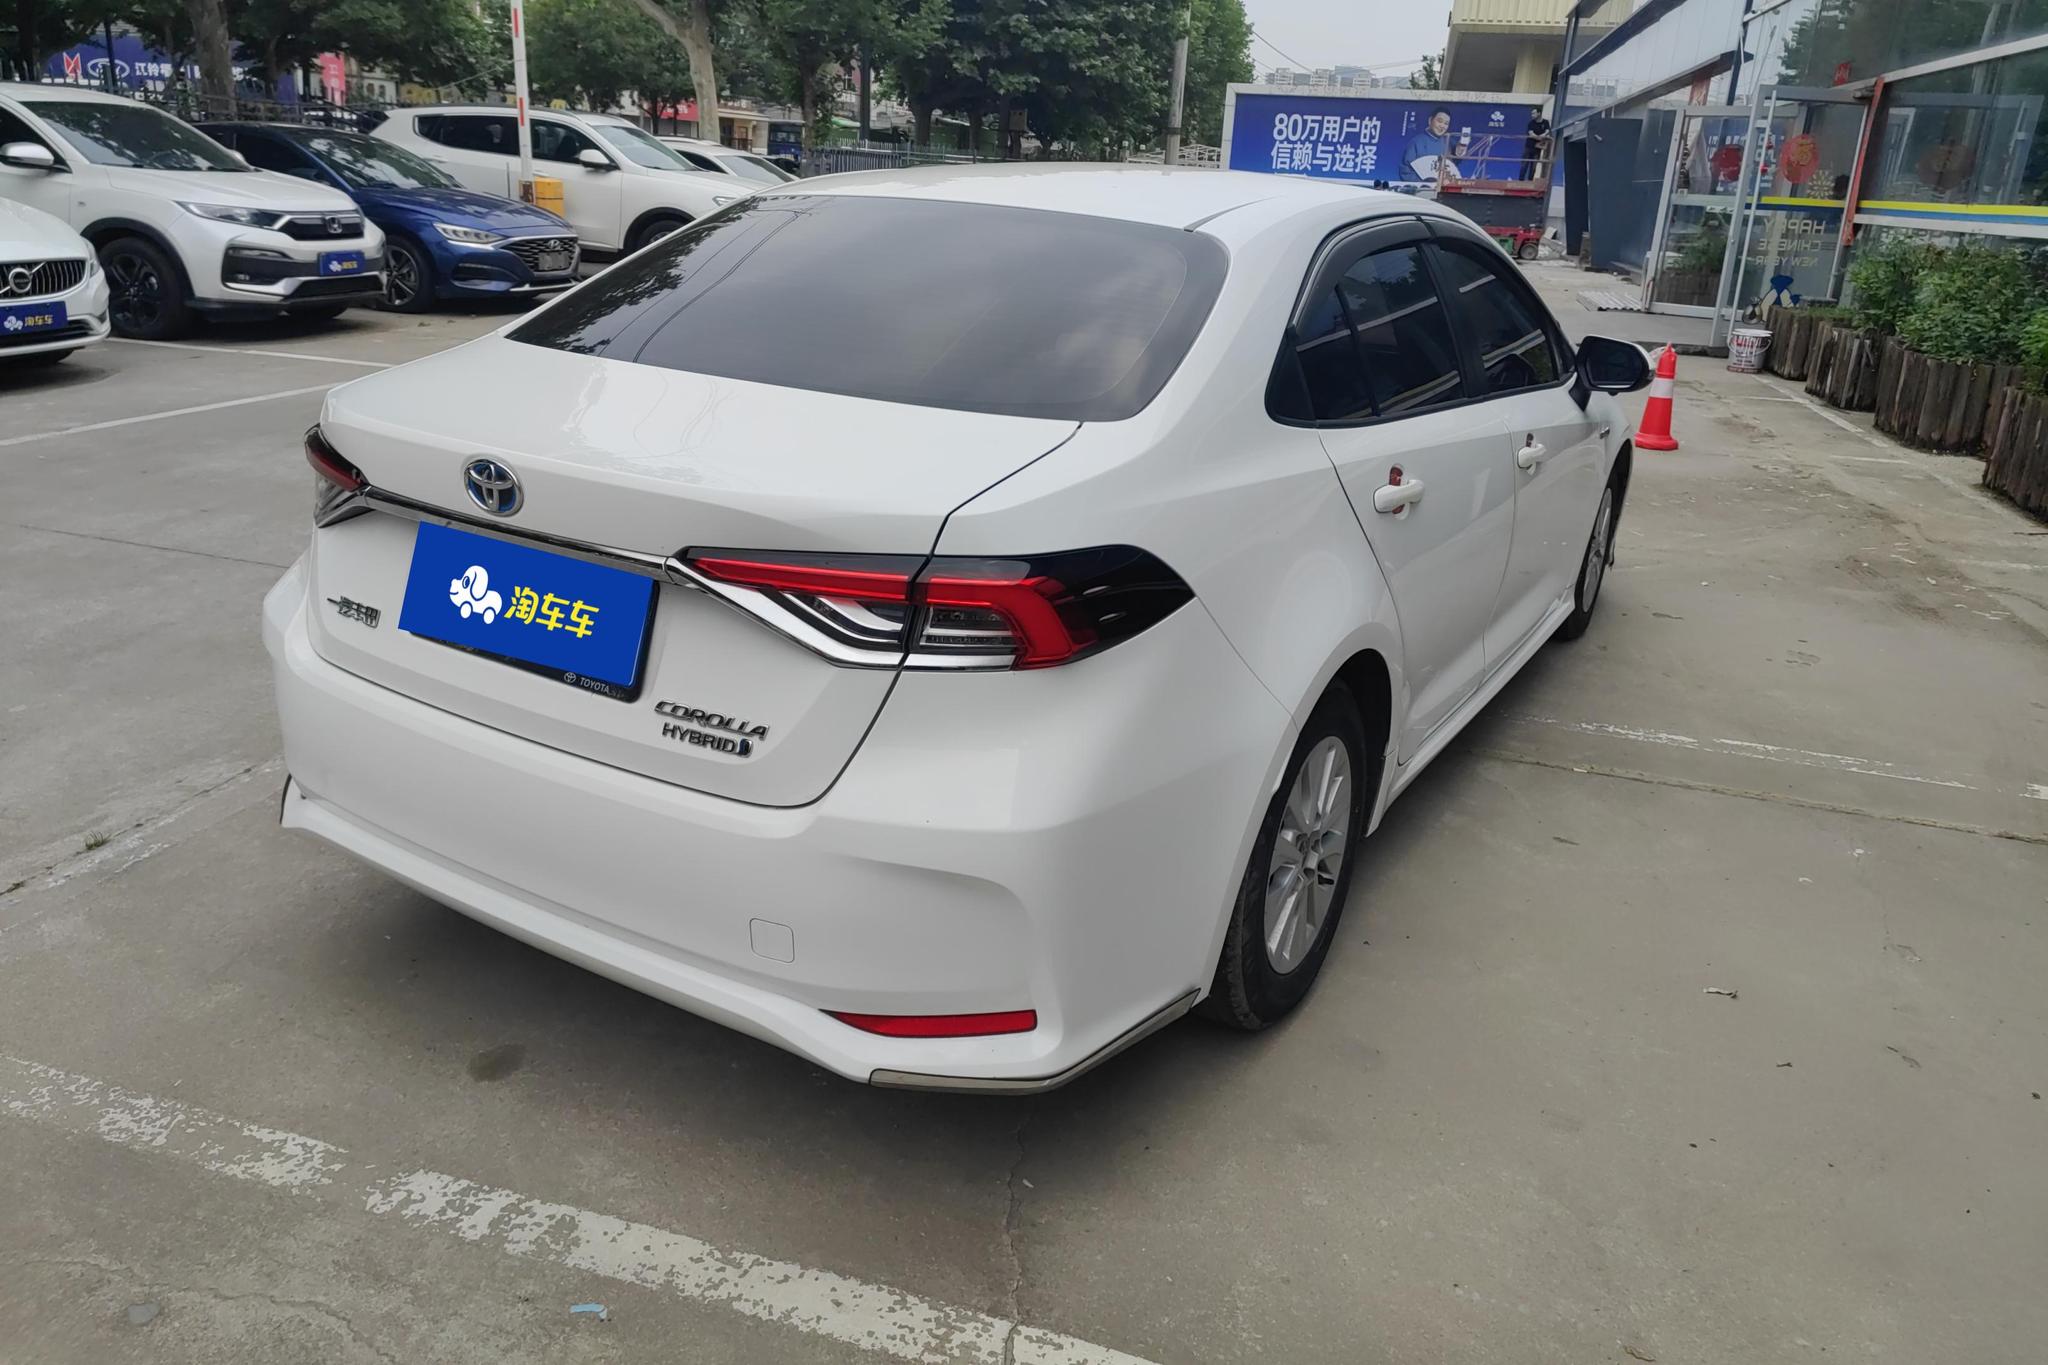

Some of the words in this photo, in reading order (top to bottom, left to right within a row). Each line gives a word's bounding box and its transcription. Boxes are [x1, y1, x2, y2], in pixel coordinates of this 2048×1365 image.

[1273, 112, 1381, 143] 80万用户的
[1271, 140, 1378, 174] 信赖与选择
[579, 677, 610, 694] TOYOTA
[654, 700, 770, 742] COROLLA
[662, 722, 739, 754] HYBRID
